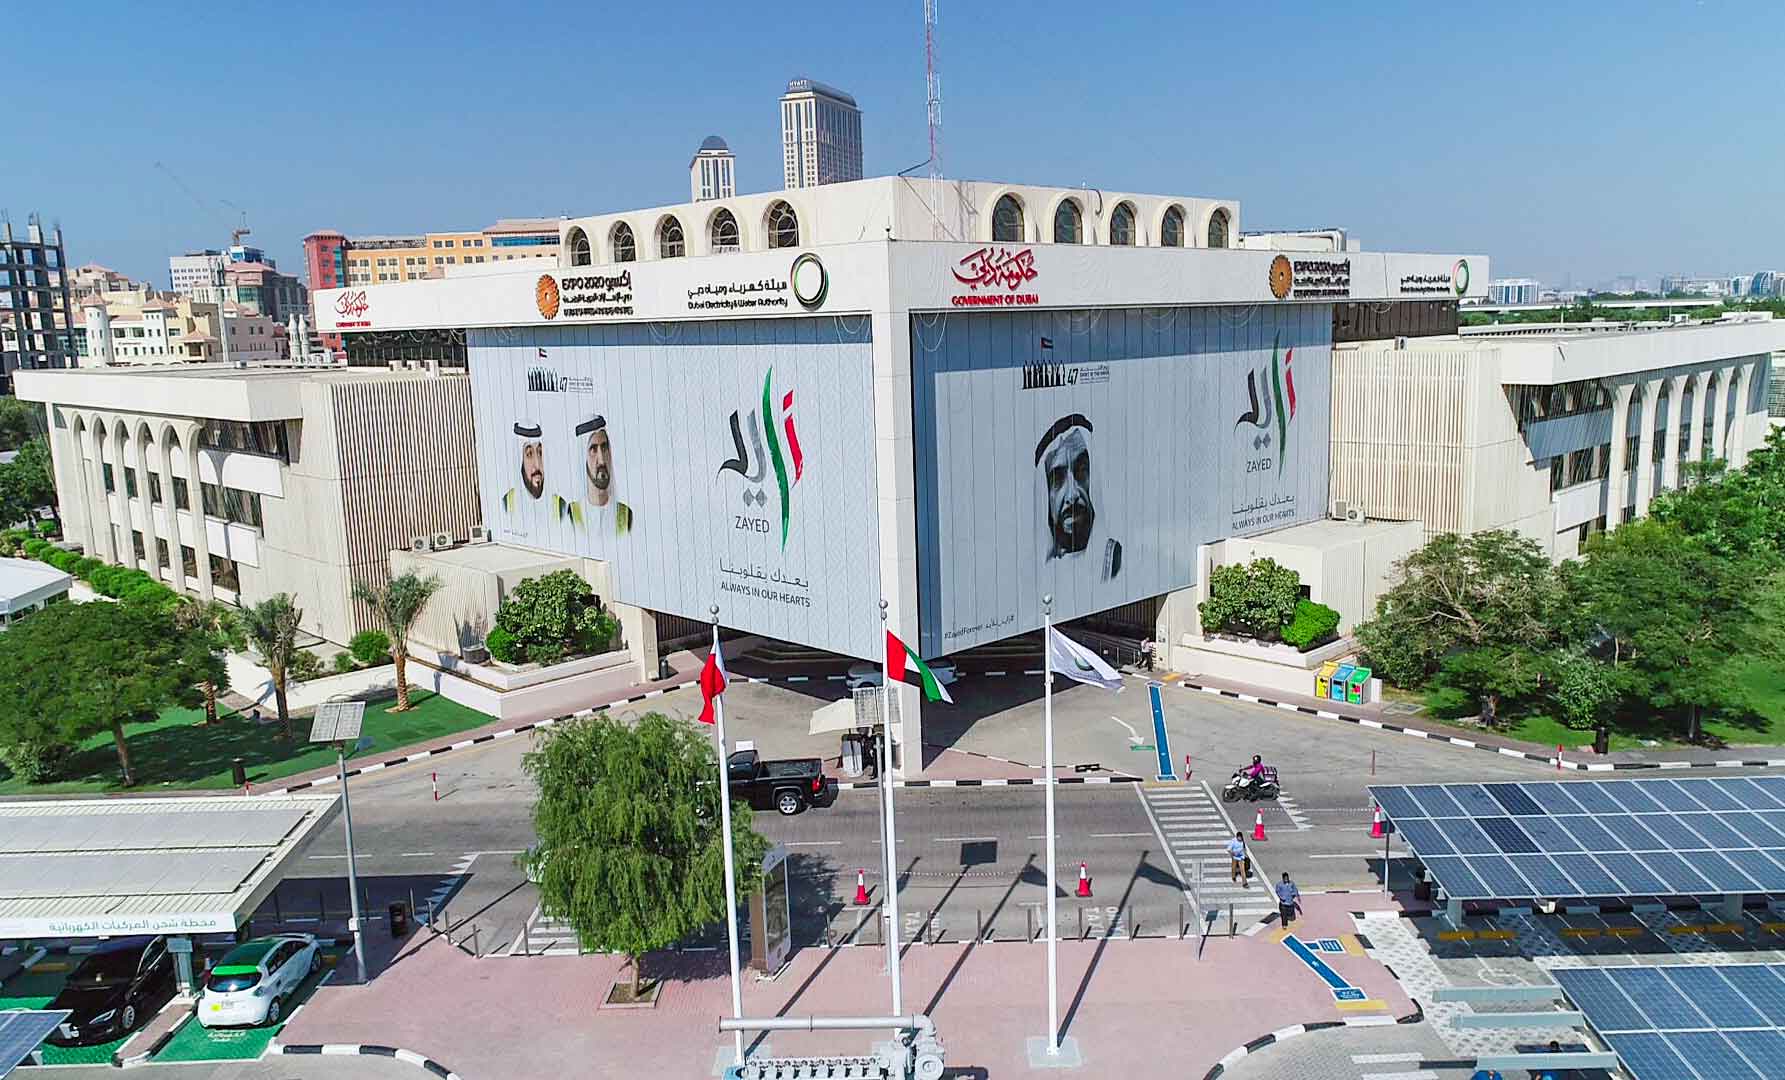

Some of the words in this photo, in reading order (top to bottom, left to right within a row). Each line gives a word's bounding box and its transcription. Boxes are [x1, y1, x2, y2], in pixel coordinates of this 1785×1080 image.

[561, 277, 583, 290] EXPO
[584, 275, 605, 289] 2020
[952, 295, 1003, 305] GOVERNMENT
[1004, 295, 1015, 304] OF
[1016, 294, 1039, 304] DUBAI
[1067, 368, 1079, 386] 47
[1246, 458, 1272, 473] ZAYED
[735, 515, 770, 533] ZAYED
[1232, 518, 1256, 530] ALWAYS
[1262, 512, 1274, 524] OUR
[719, 556, 767, 583] بقلوبنا
[770, 567, 809, 592] بعدك
[721, 581, 751, 596] ALWAYS
[751, 587, 760, 597] IN
[761, 589, 778, 601] OUR
[780, 592, 811, 608] HEARTS
